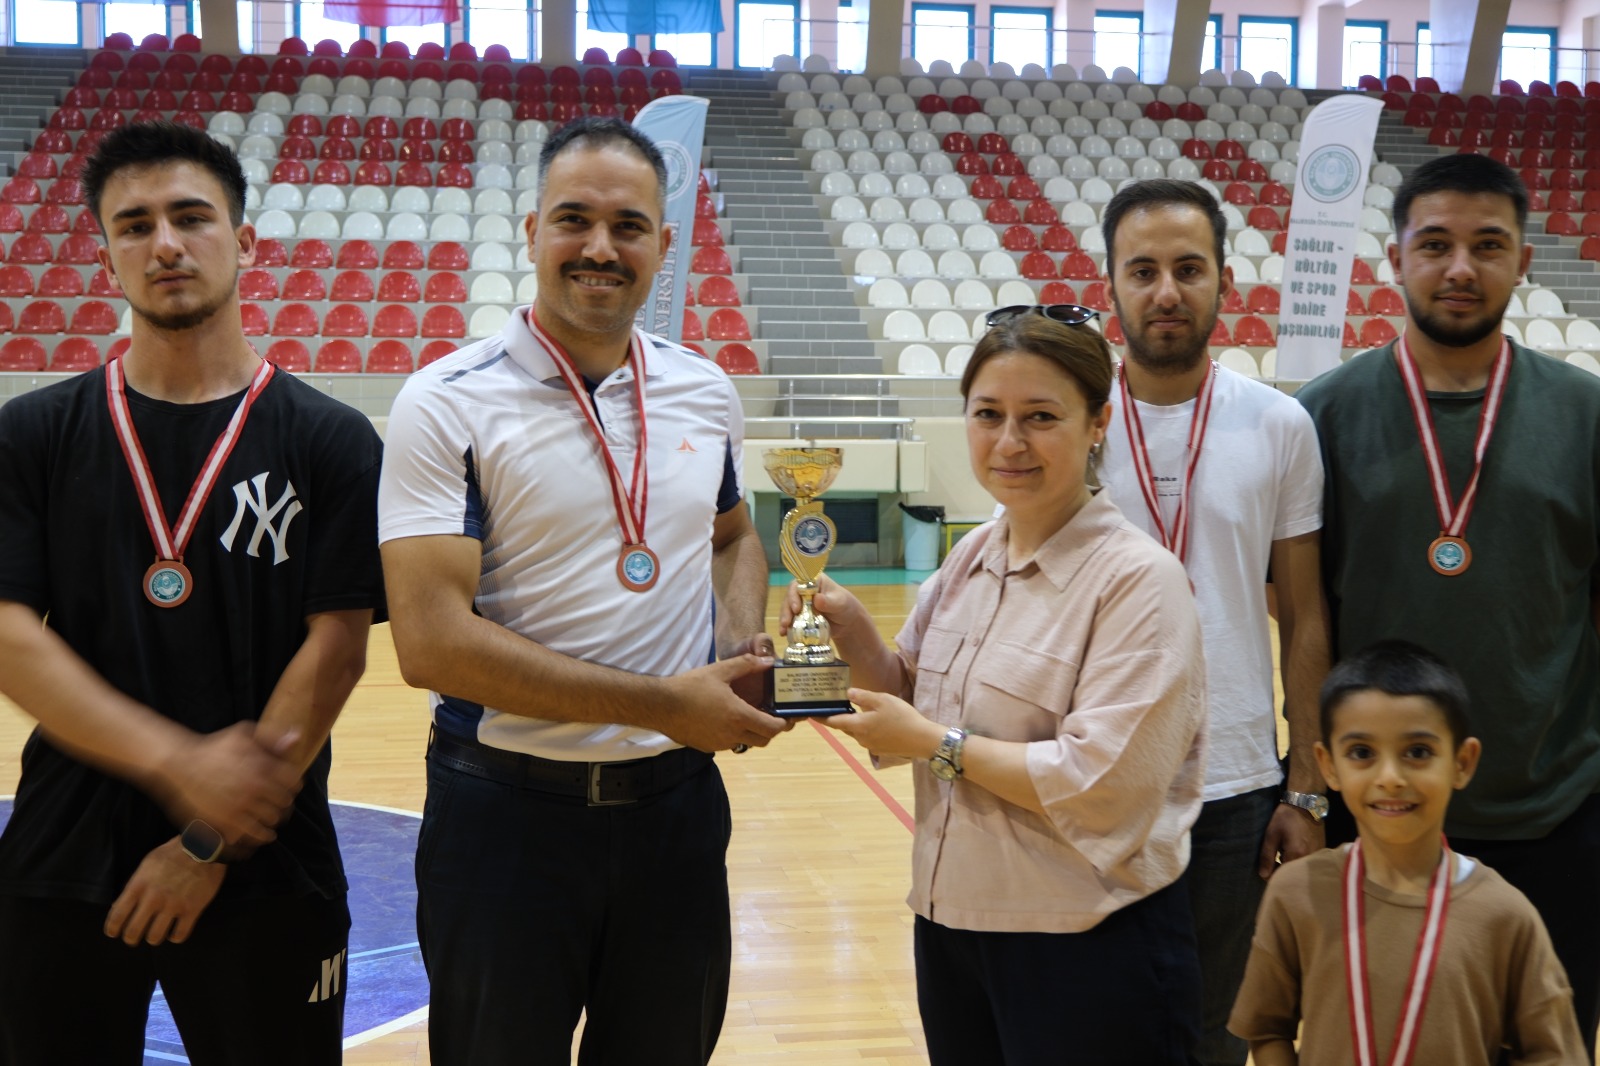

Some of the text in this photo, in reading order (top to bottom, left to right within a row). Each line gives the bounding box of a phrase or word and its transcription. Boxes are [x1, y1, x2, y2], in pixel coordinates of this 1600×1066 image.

[1293, 237, 1335, 254] SAĞLIK
[1294, 257, 1337, 276] KÜLTÜR
[1290, 281, 1337, 297] VE SPOR
[1292, 301, 1327, 317] DAİRE
[220, 471, 303, 566] NY
